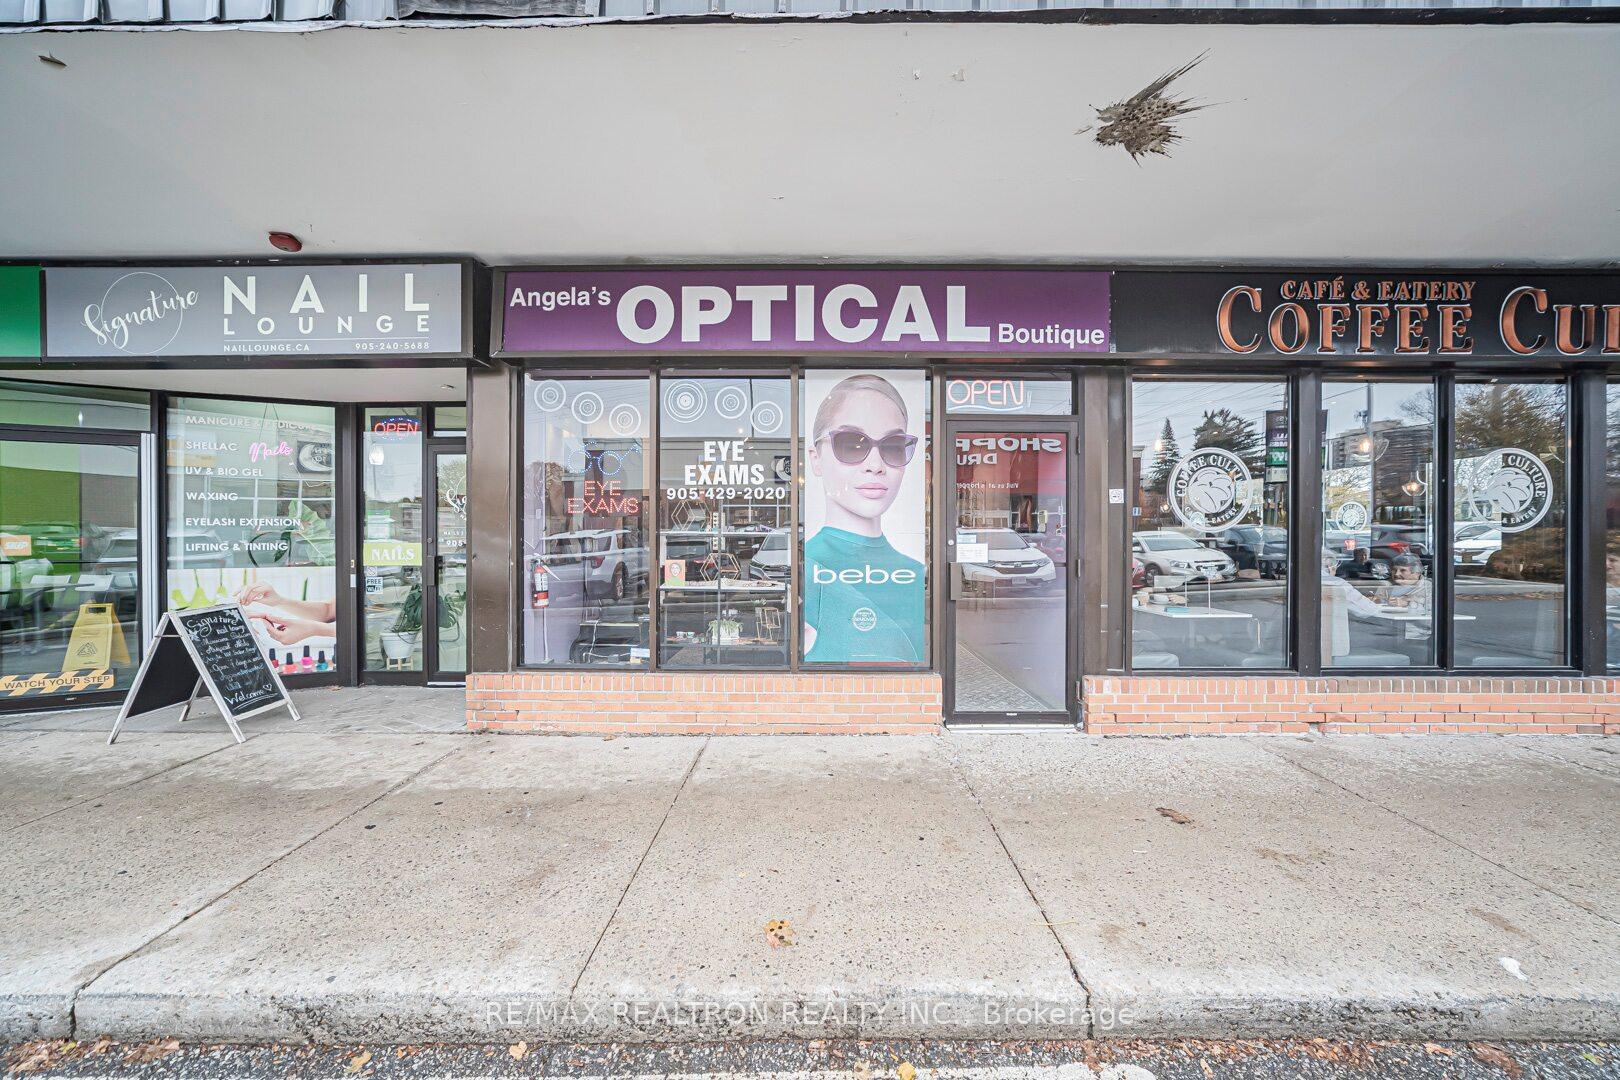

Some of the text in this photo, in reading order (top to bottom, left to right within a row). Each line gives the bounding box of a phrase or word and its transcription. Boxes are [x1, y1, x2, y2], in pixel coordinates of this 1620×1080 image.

[224, 273, 430, 315] NAIL
[1280, 275, 1477, 300] CAFÉ & EATERY
[81, 290, 199, 350] Signature
[509, 284, 1105, 349] Angela's OPTICAL Boutique
[1217, 285, 1475, 354] COFFEE
[224, 314, 430, 335] LOUNGE
[224, 344, 310, 352] NAILLOUNGE.CA
[355, 342, 430, 350] 905-240-5688
[948, 379, 1024, 405] OPEN
[186, 415, 249, 427] MANICURE
[374, 422, 418, 436] OPEN
[186, 441, 238, 451] SHELLAC
[704, 440, 745, 461] EYE
[186, 467, 264, 477] UV & BIO GEL
[684, 464, 765, 486] EXAMS
[1507, 455, 1547, 498] CULTURE
[584, 480, 622, 496] EYE
[666, 487, 786, 501] 905-429-2020
[186, 492, 239, 501] WAXING
[567, 498, 640, 514] EXAMS
[186, 517, 236, 526] EYELASH
[186, 542, 289, 552] LIFTING & TINTING
[371, 547, 415, 562] NAILS
[813, 564, 917, 585] bebe
[4, 675, 111, 690] WATCH YOUR STEP
[224, 690, 265, 705] Welcome
